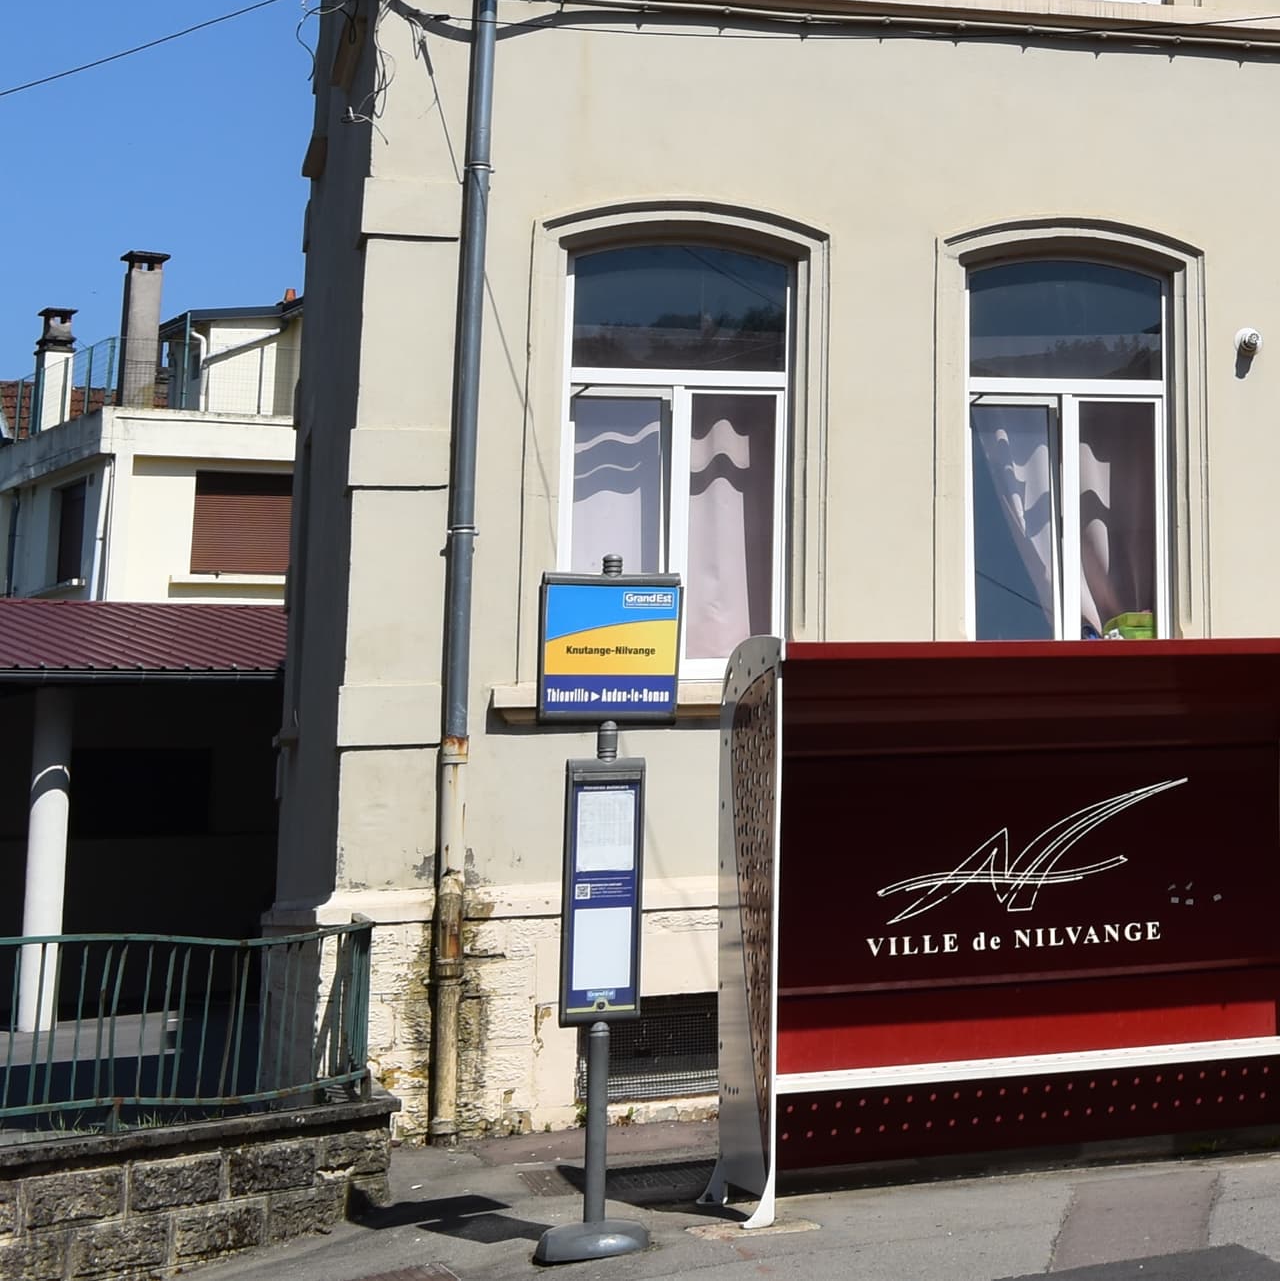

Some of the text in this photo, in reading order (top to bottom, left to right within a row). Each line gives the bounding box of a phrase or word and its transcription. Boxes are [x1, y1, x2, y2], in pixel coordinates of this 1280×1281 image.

[566, 645, 656, 656] Knutange-Nilvange
[547, 688, 589, 702] Thionville
[866, 921, 1161, 957] VILLE de NILVANGE
